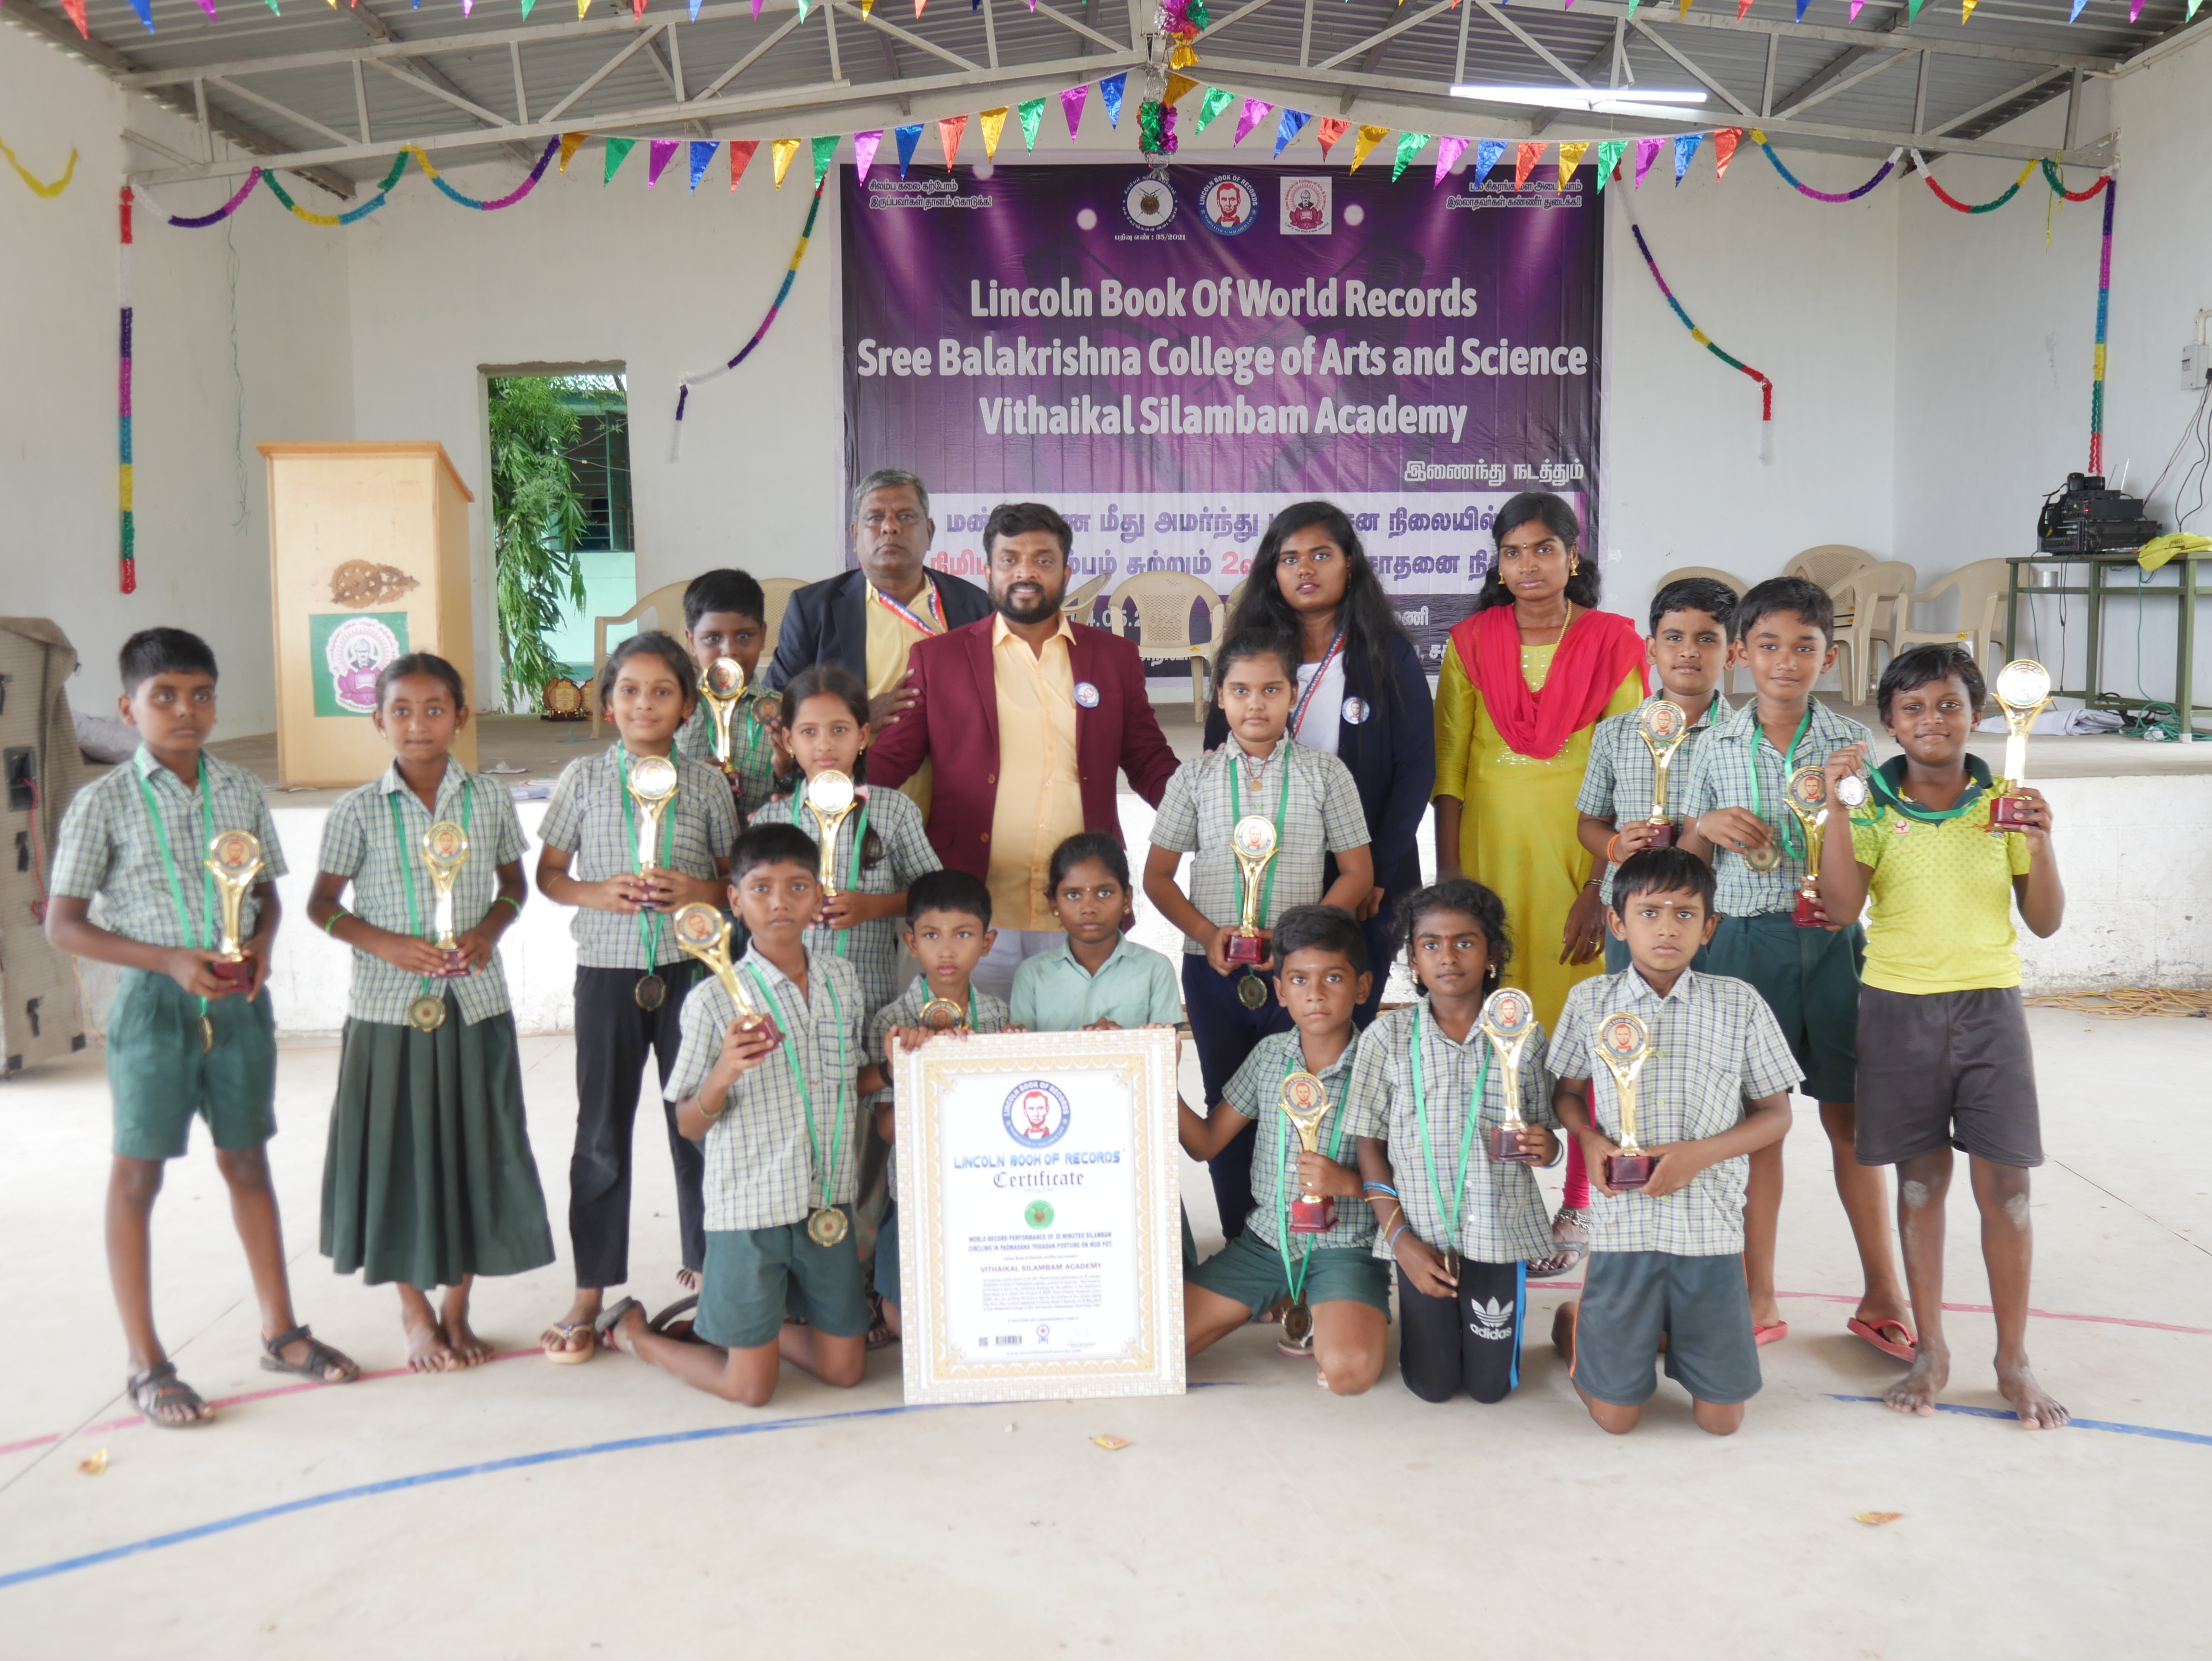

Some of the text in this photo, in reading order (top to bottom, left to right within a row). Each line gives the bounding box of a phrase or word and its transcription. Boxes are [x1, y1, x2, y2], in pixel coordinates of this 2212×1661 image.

[869, 179, 958, 195] சிலம்ப கலை கற்போம்
[1199, 180, 1214, 205] LINCOLN
[1214, 174, 1231, 183] BOOK
[1240, 179, 1258, 206] RECORDS
[869, 195, 992, 211] இருப்பவர்கள் தானம் கொடுக்க!
[1446, 195, 1506, 211] இல்லாதவர்கள்
[1543, 195, 1582, 210] துடைக்க!!
[1114, 233, 1132, 241] பதிவு
[1156, 233, 1185, 241] 35/2021
[971, 276, 1477, 317] Lincoln Book Of World Records
[857, 335, 1588, 386] Sree Balakrishna College of Arts and Science
[978, 394, 1468, 443] Vithaikal Silambam Academy
[1404, 458, 1584, 486] இணைந்து நடத்தும்
[1100, 503, 1145, 543] மீது
[1154, 505, 1259, 543] அமர்ந்து
[1388, 504, 1498, 539] நிலையில்
[1126, 548, 1211, 575] சுற்றும்
[1003, 1081, 1069, 1117] LINCOLN BOOK OF RECORDS
[954, 1151, 1120, 1169] LINCOLN BOOK OF RECORDS
[993, 1170, 1084, 1188] Certificate
[1009, 1233, 1046, 1241] PERFORMANCE
[1021, 1264, 1063, 1272] SILAMBAM
[1470, 1323, 1512, 1340] adidas
